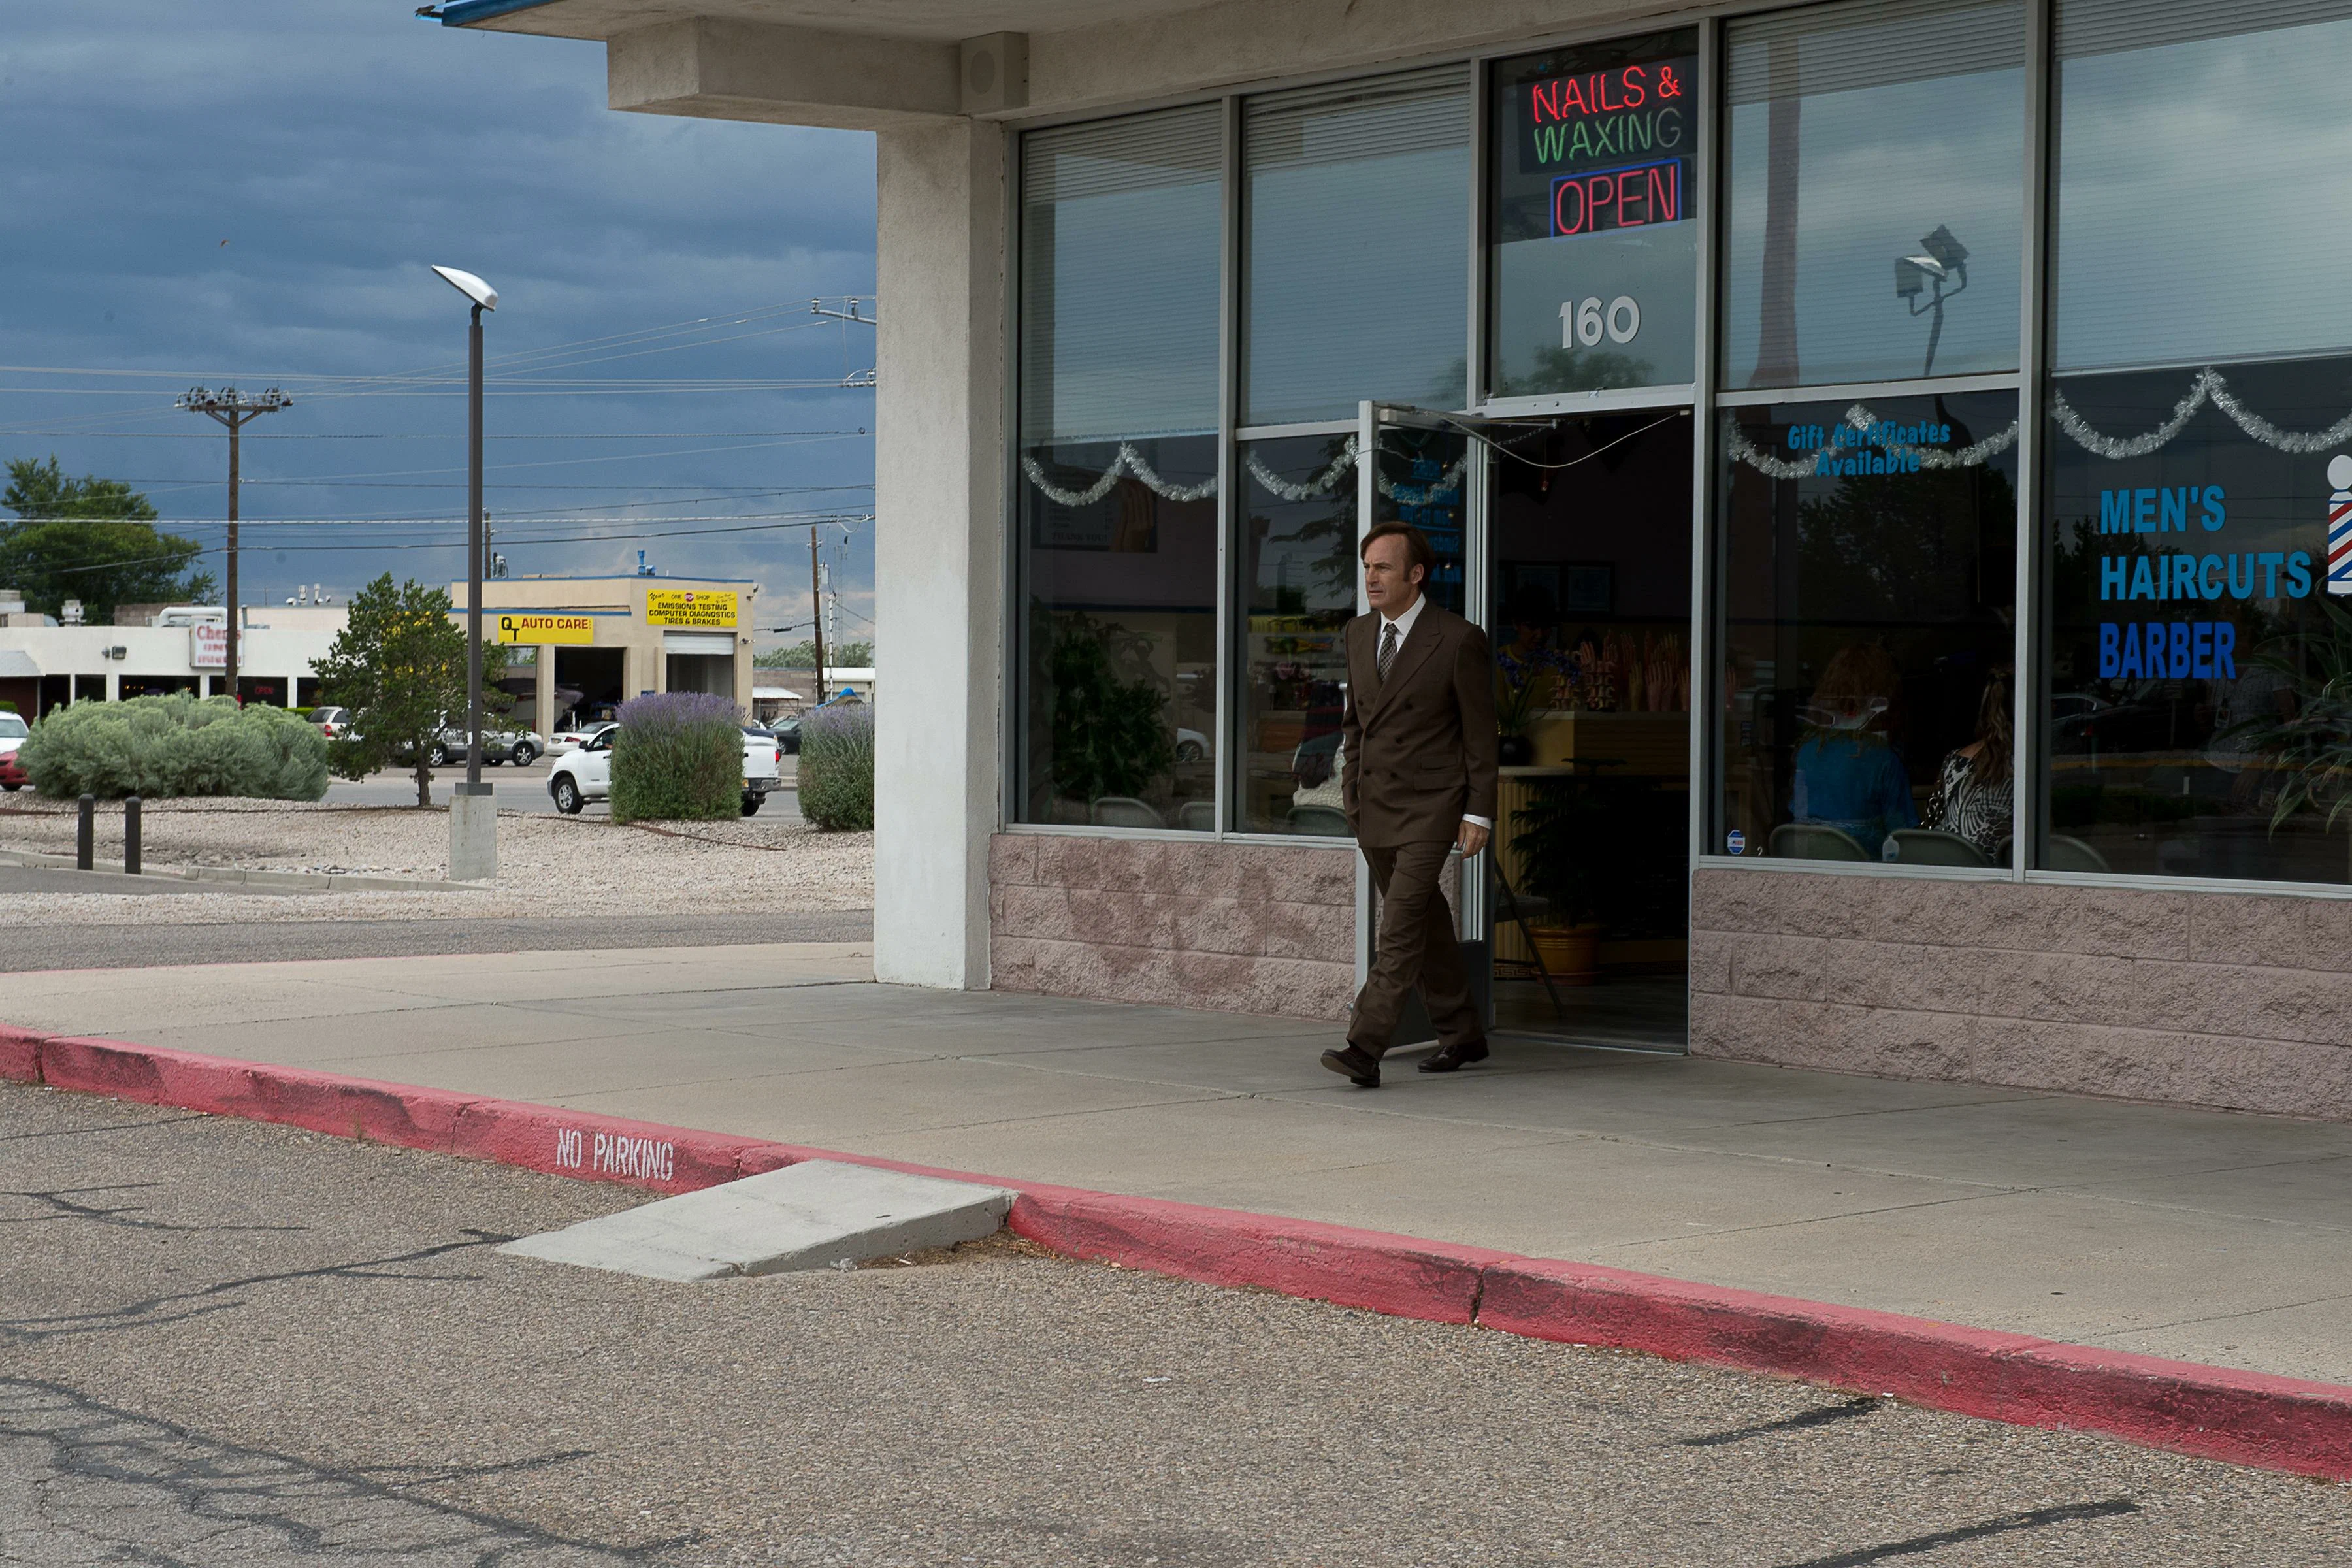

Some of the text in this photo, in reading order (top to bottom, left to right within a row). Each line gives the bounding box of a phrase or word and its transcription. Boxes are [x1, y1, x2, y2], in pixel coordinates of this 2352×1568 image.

[1532, 65, 1681, 123] NAILS &
[1533, 107, 1682, 164] WAXING
[1556, 165, 1676, 235] OPEN
[1558, 295, 1641, 349] 160
[1788, 420, 1951, 450] Gift Certificates
[1815, 451, 1921, 478] Available
[2100, 485, 2227, 534] MEN'S
[2100, 551, 2312, 601] HAIRCUTS
[521, 617, 553, 629] AUTO
[557, 618, 588, 629] CARE
[2099, 621, 2237, 680] BARBER
[557, 1128, 674, 1181] NO PARKING
